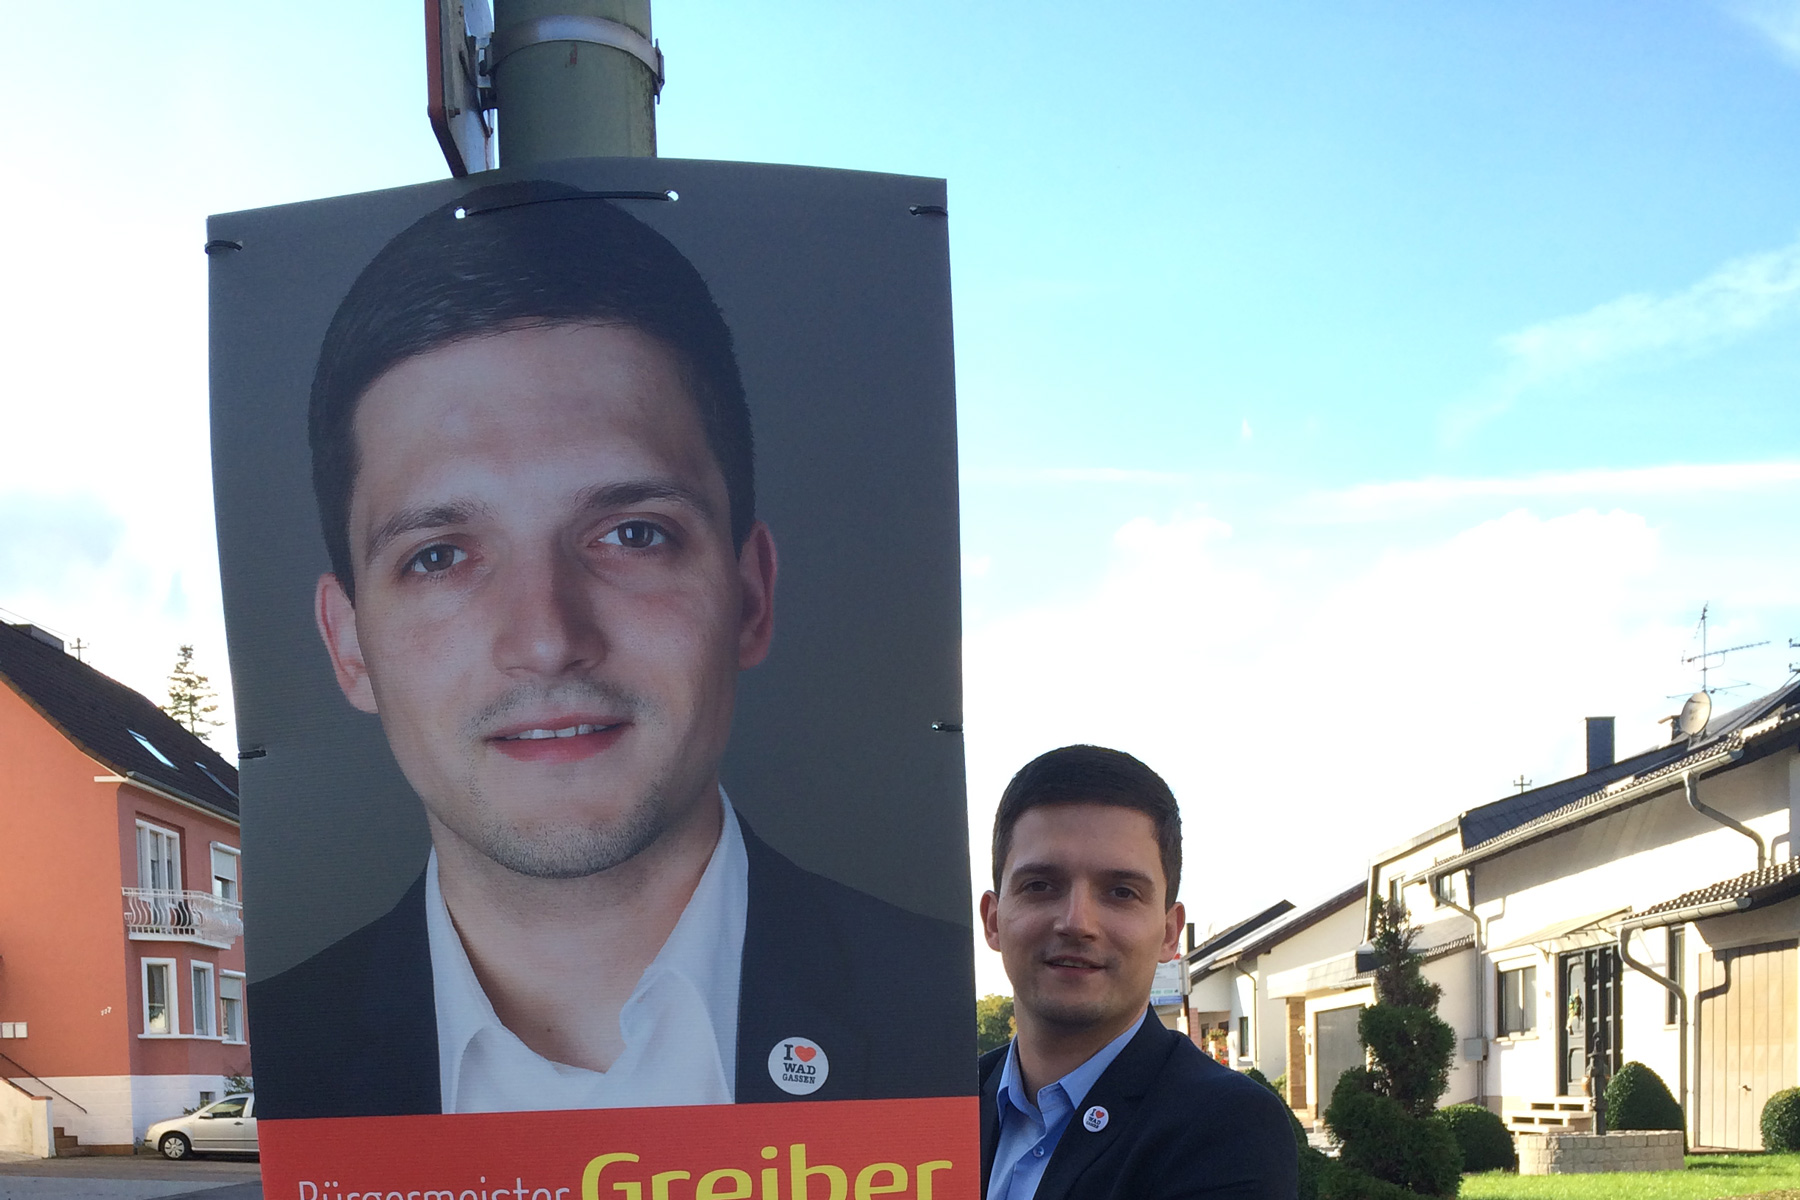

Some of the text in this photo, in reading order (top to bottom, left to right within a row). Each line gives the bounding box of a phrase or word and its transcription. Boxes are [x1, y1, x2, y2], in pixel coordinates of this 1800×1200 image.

[783, 1044, 794, 1060] I
[783, 1063, 816, 1075] WAD
[782, 1074, 816, 1084] GASSEN
